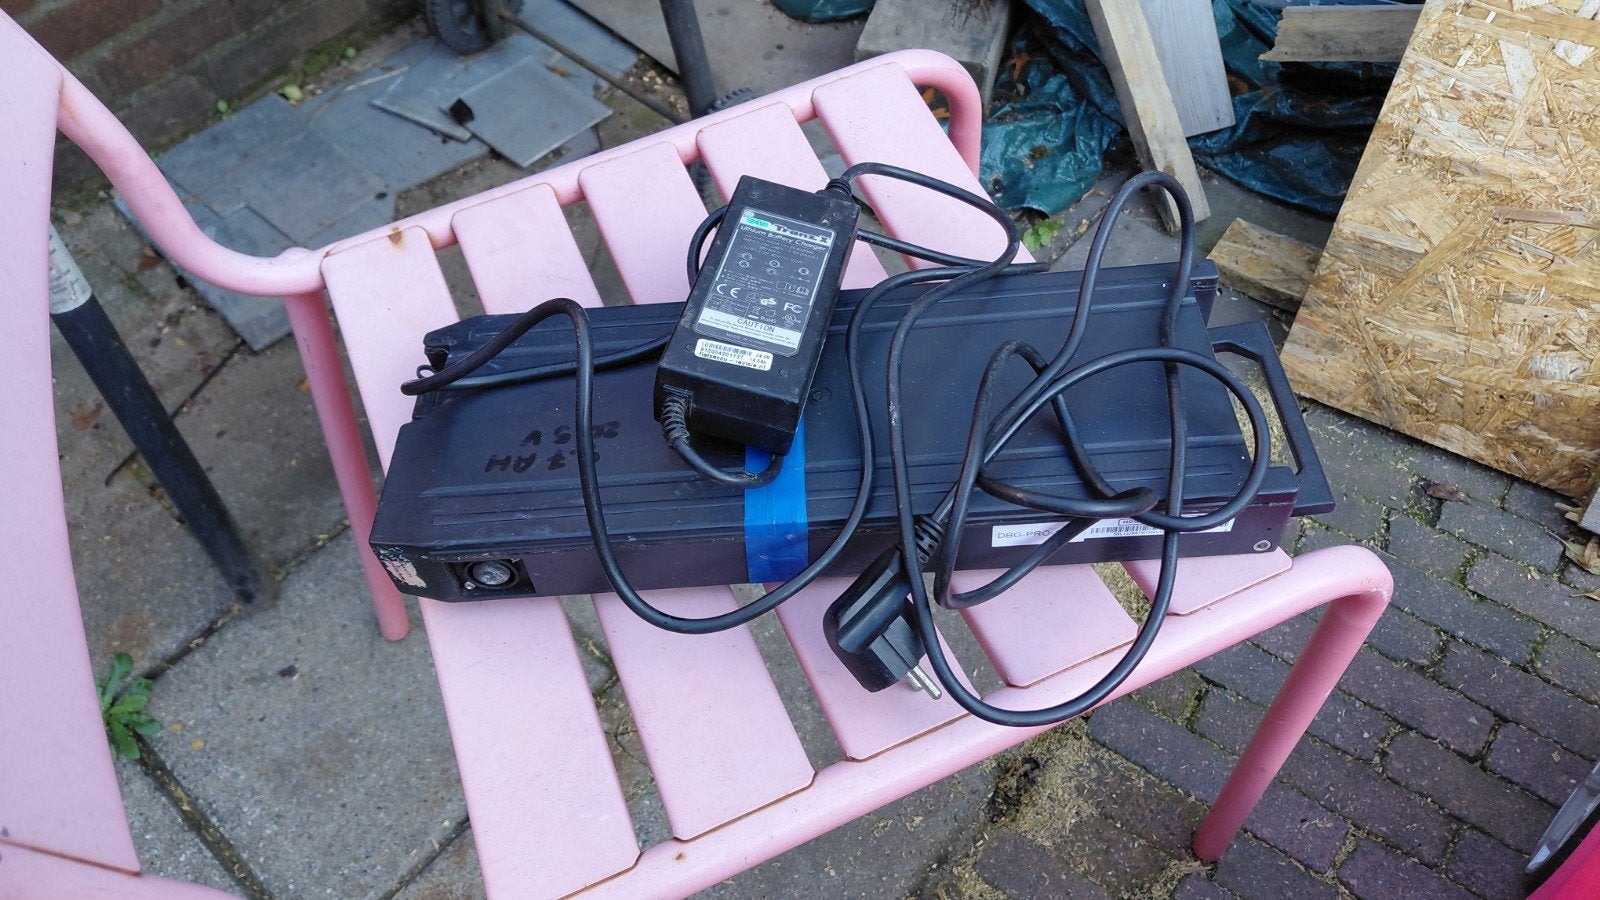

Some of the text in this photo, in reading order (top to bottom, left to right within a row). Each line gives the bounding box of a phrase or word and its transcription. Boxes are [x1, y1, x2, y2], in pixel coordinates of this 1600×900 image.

[740, 225, 766, 236] Lithium
[767, 231, 793, 244] Battery
[795, 239, 826, 253] Charger
[716, 283, 741, 299] CE
[783, 302, 803, 314] FC
[737, 317, 775, 333] CAUTION
